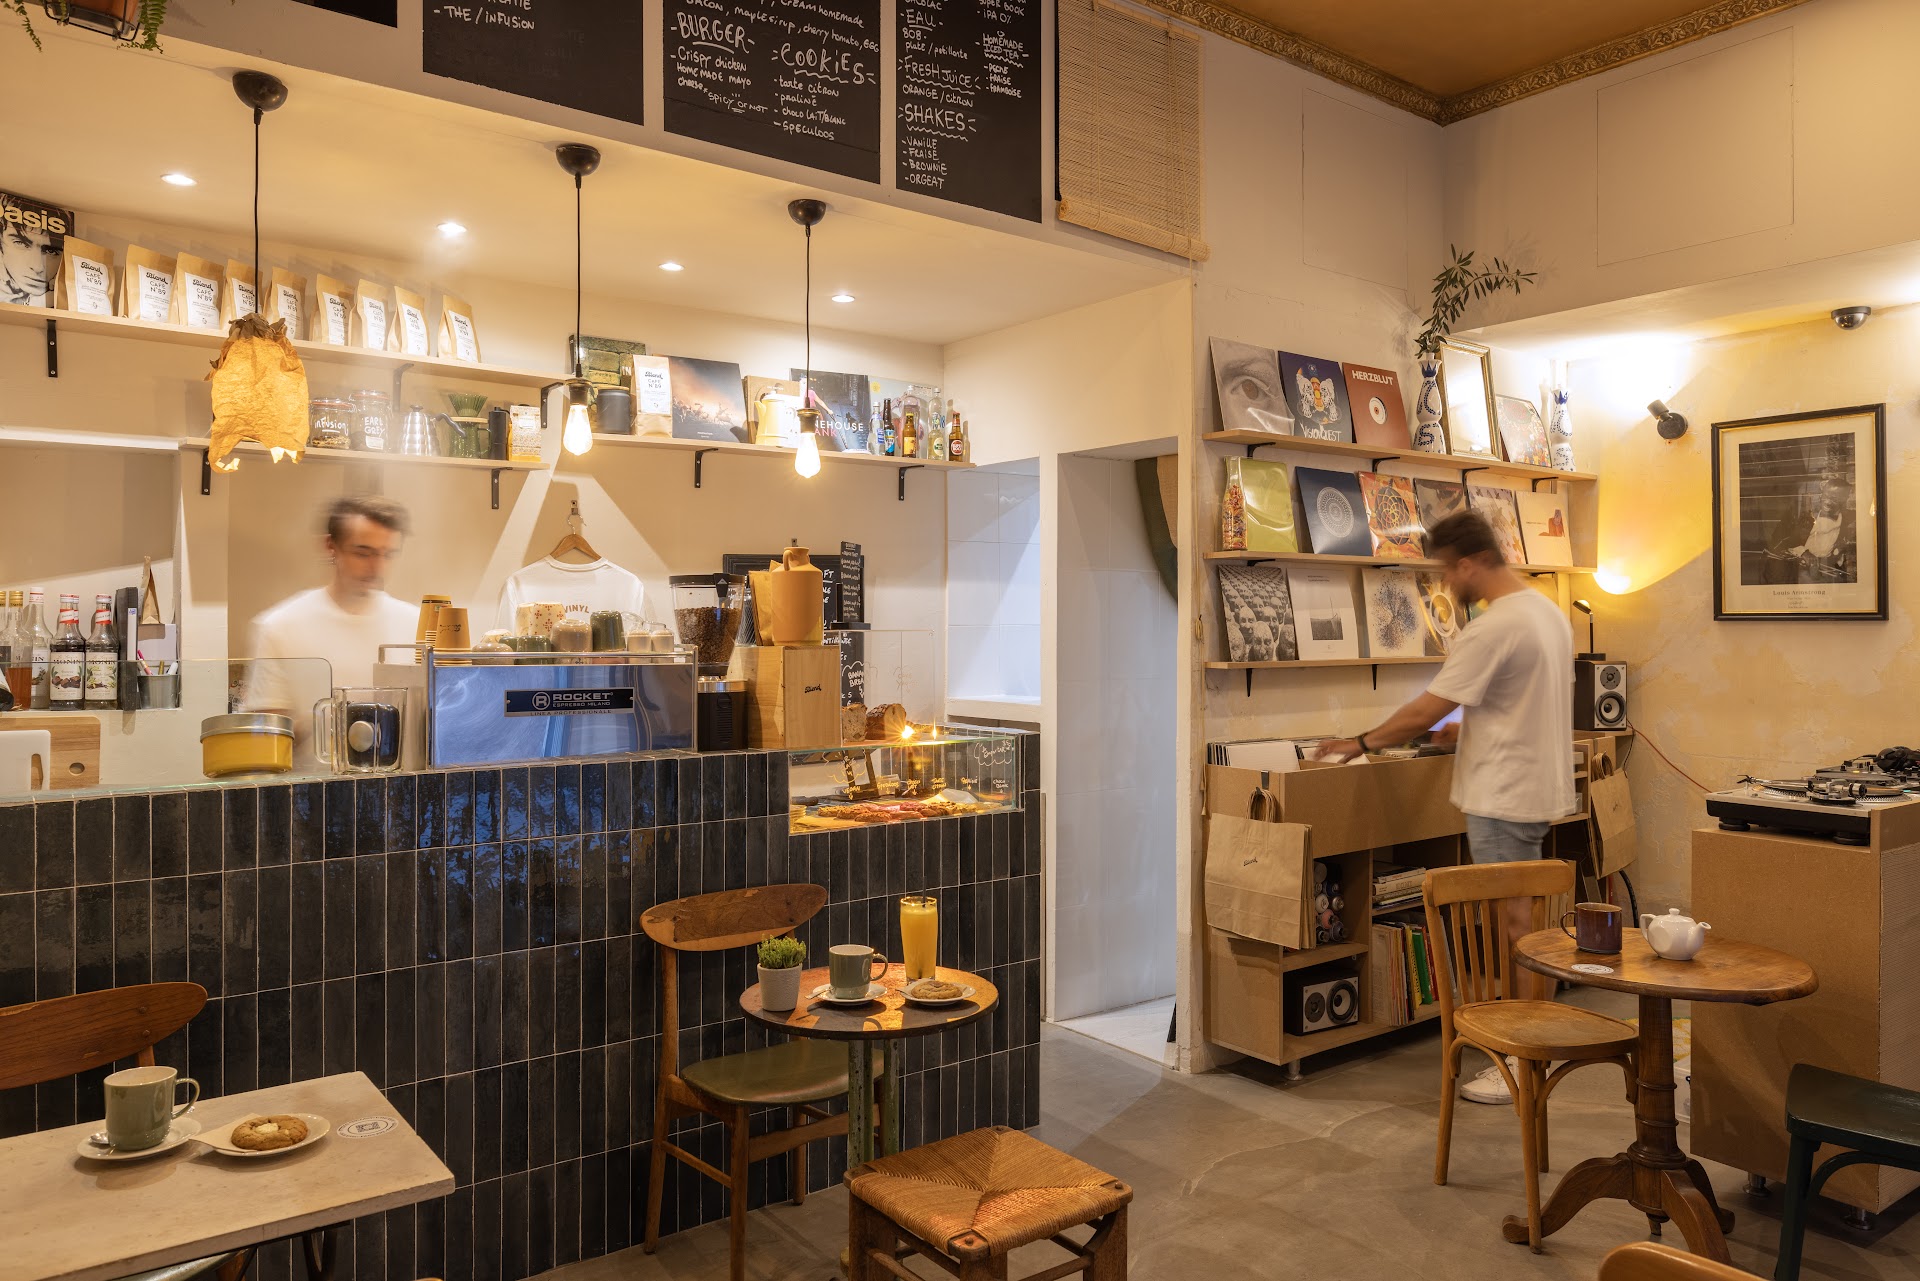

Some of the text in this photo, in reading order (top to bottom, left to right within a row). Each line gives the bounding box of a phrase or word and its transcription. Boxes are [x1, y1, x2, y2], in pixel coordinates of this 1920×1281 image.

[906, 9, 937, 27] EAU
[677, 12, 749, 54] BURGER
[1003, 48, 1020, 60] TEA
[904, 103, 966, 131] SHAKES
[909, 174, 945, 190] ORGEAT
[0, 204, 66, 234] asis
[1351, 369, 1394, 386] HERZBLUT
